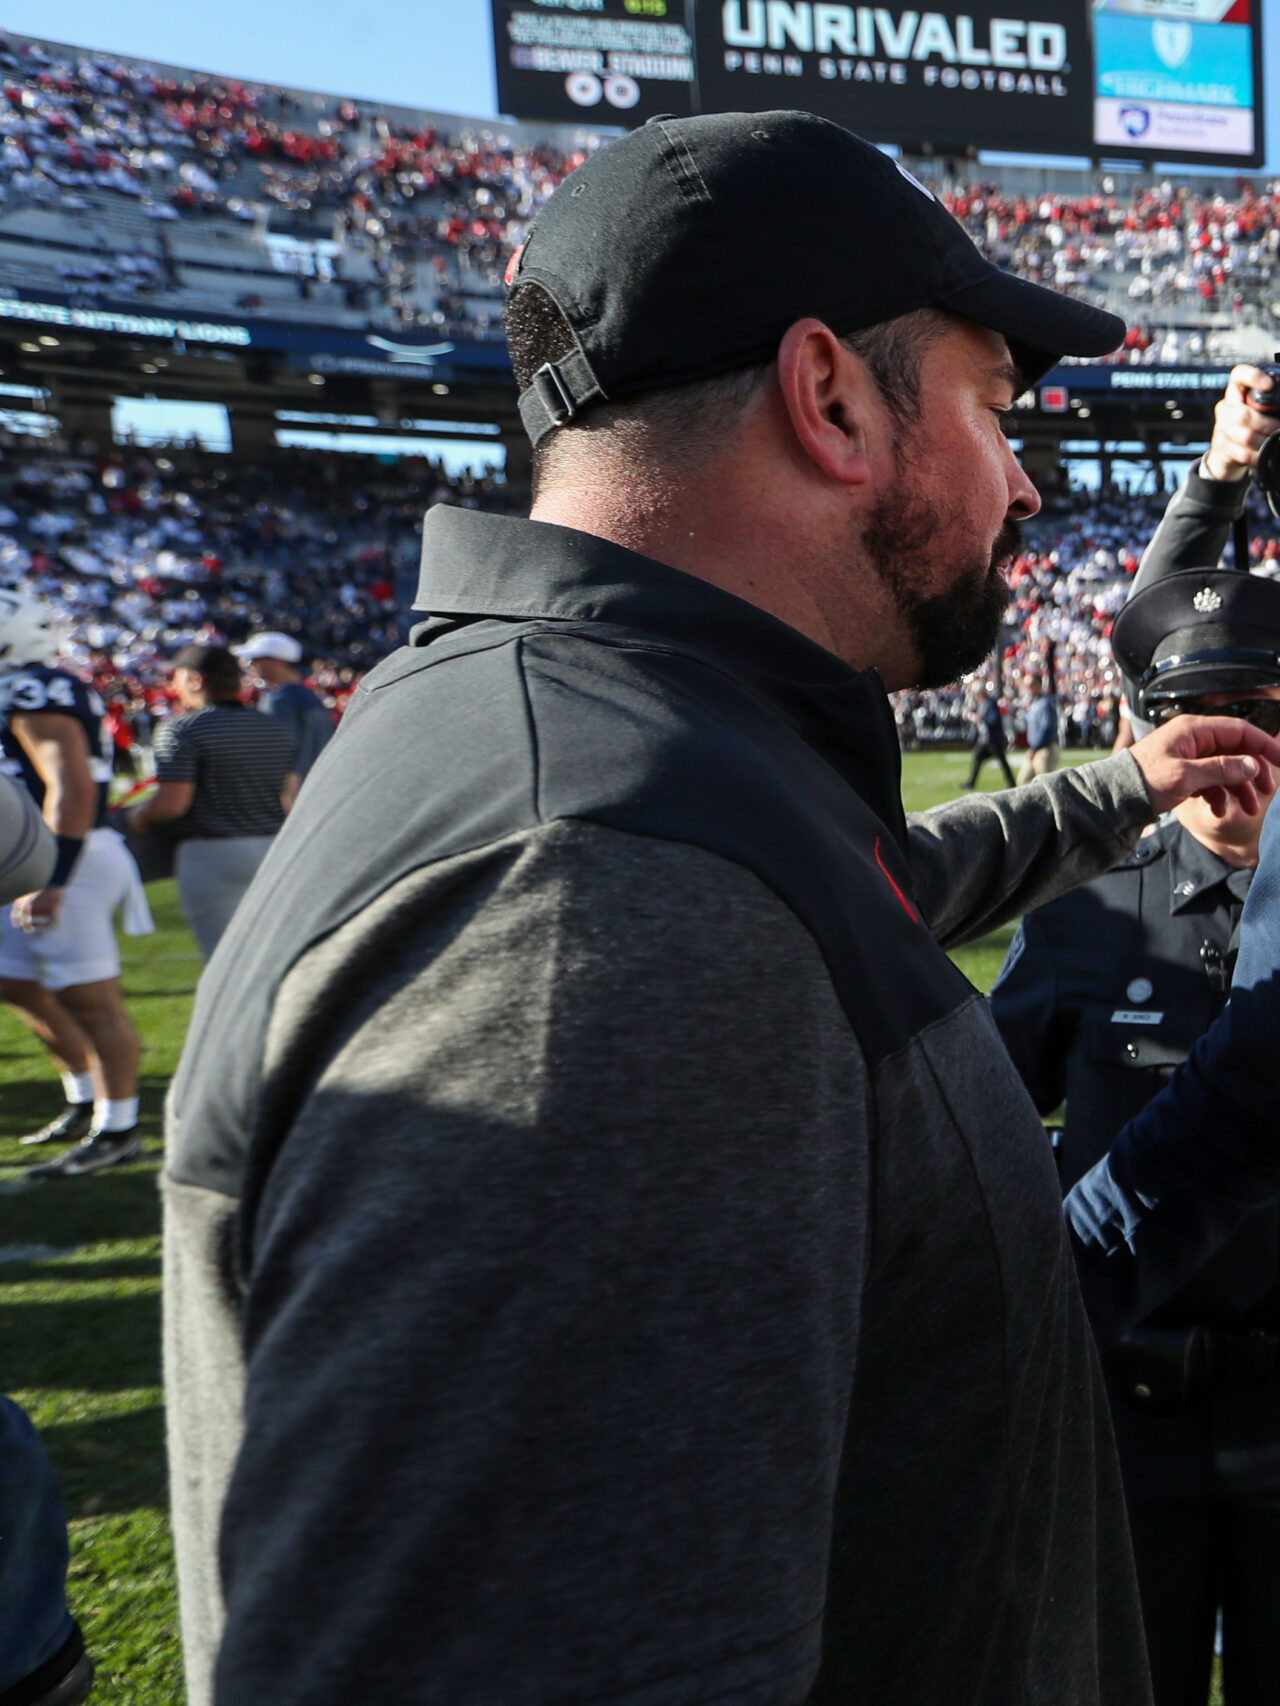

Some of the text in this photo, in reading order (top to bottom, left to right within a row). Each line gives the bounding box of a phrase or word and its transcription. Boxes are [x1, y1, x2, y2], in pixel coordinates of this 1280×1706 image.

[721, 0, 1067, 72] UNRIVALED
[724, 50, 1069, 97] PENN STATE FOOTBALL
[11, 675, 76, 710] 34
